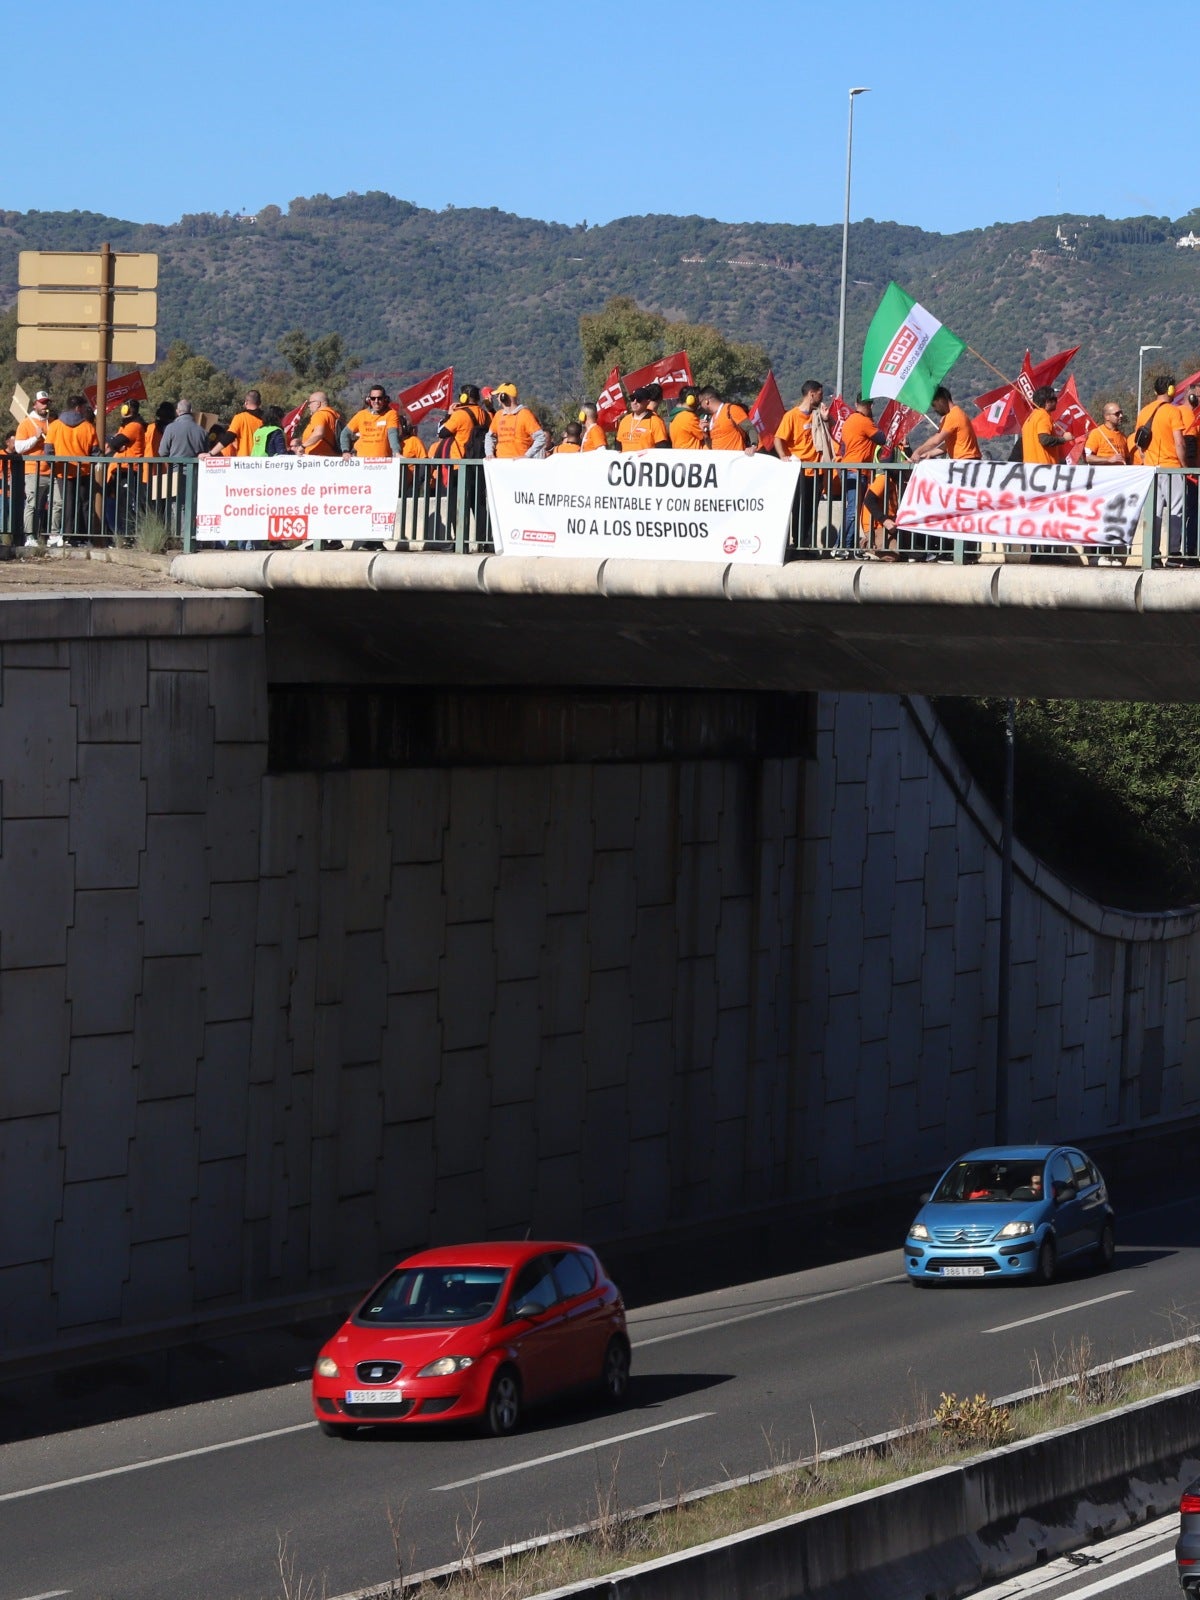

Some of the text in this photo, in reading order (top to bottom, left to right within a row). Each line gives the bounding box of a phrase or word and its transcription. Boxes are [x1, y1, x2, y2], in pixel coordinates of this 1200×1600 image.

[234, 460, 262, 470] Hitachi
[265, 459, 294, 470] Energy
[297, 459, 321, 470] Spain
[607, 457, 718, 489] CÓRDOBA
[225, 483, 372, 498] Inversiones de primera
[907, 477, 1105, 521] INVERSIONES
[224, 504, 373, 517] Condiciones de tercera
[514, 491, 765, 512] UNA EMPRESA RENTABLE Y CON BENEFICIOS
[270, 516, 307, 538] USO
[567, 518, 709, 538] NO A LOS DESPIDOS
